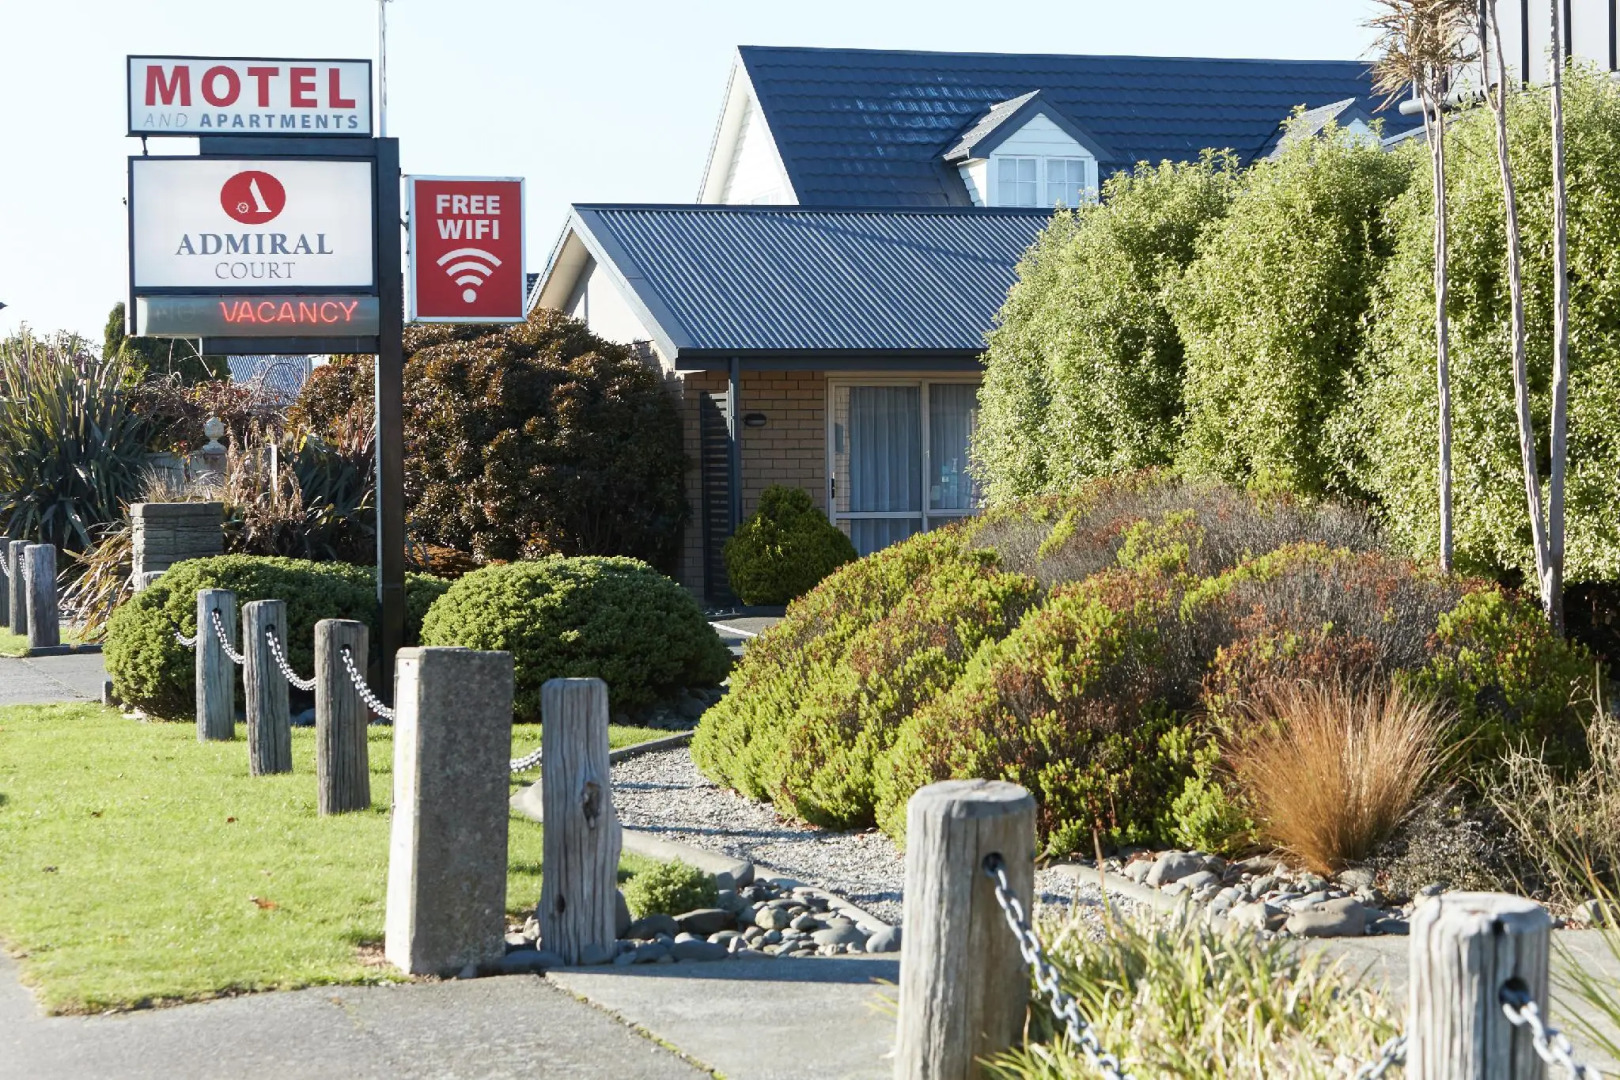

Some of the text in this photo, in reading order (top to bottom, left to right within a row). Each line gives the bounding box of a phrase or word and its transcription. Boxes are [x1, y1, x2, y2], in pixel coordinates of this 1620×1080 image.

[145, 65, 355, 108] MOTEL
[144, 113, 358, 128] AND APARTMENTS
[436, 194, 500, 214] FREE
[437, 219, 499, 240] WIFI
[175, 233, 334, 256] ADMIRAL
[215, 262, 295, 279] COURT
[219, 301, 358, 323] VACANCY
